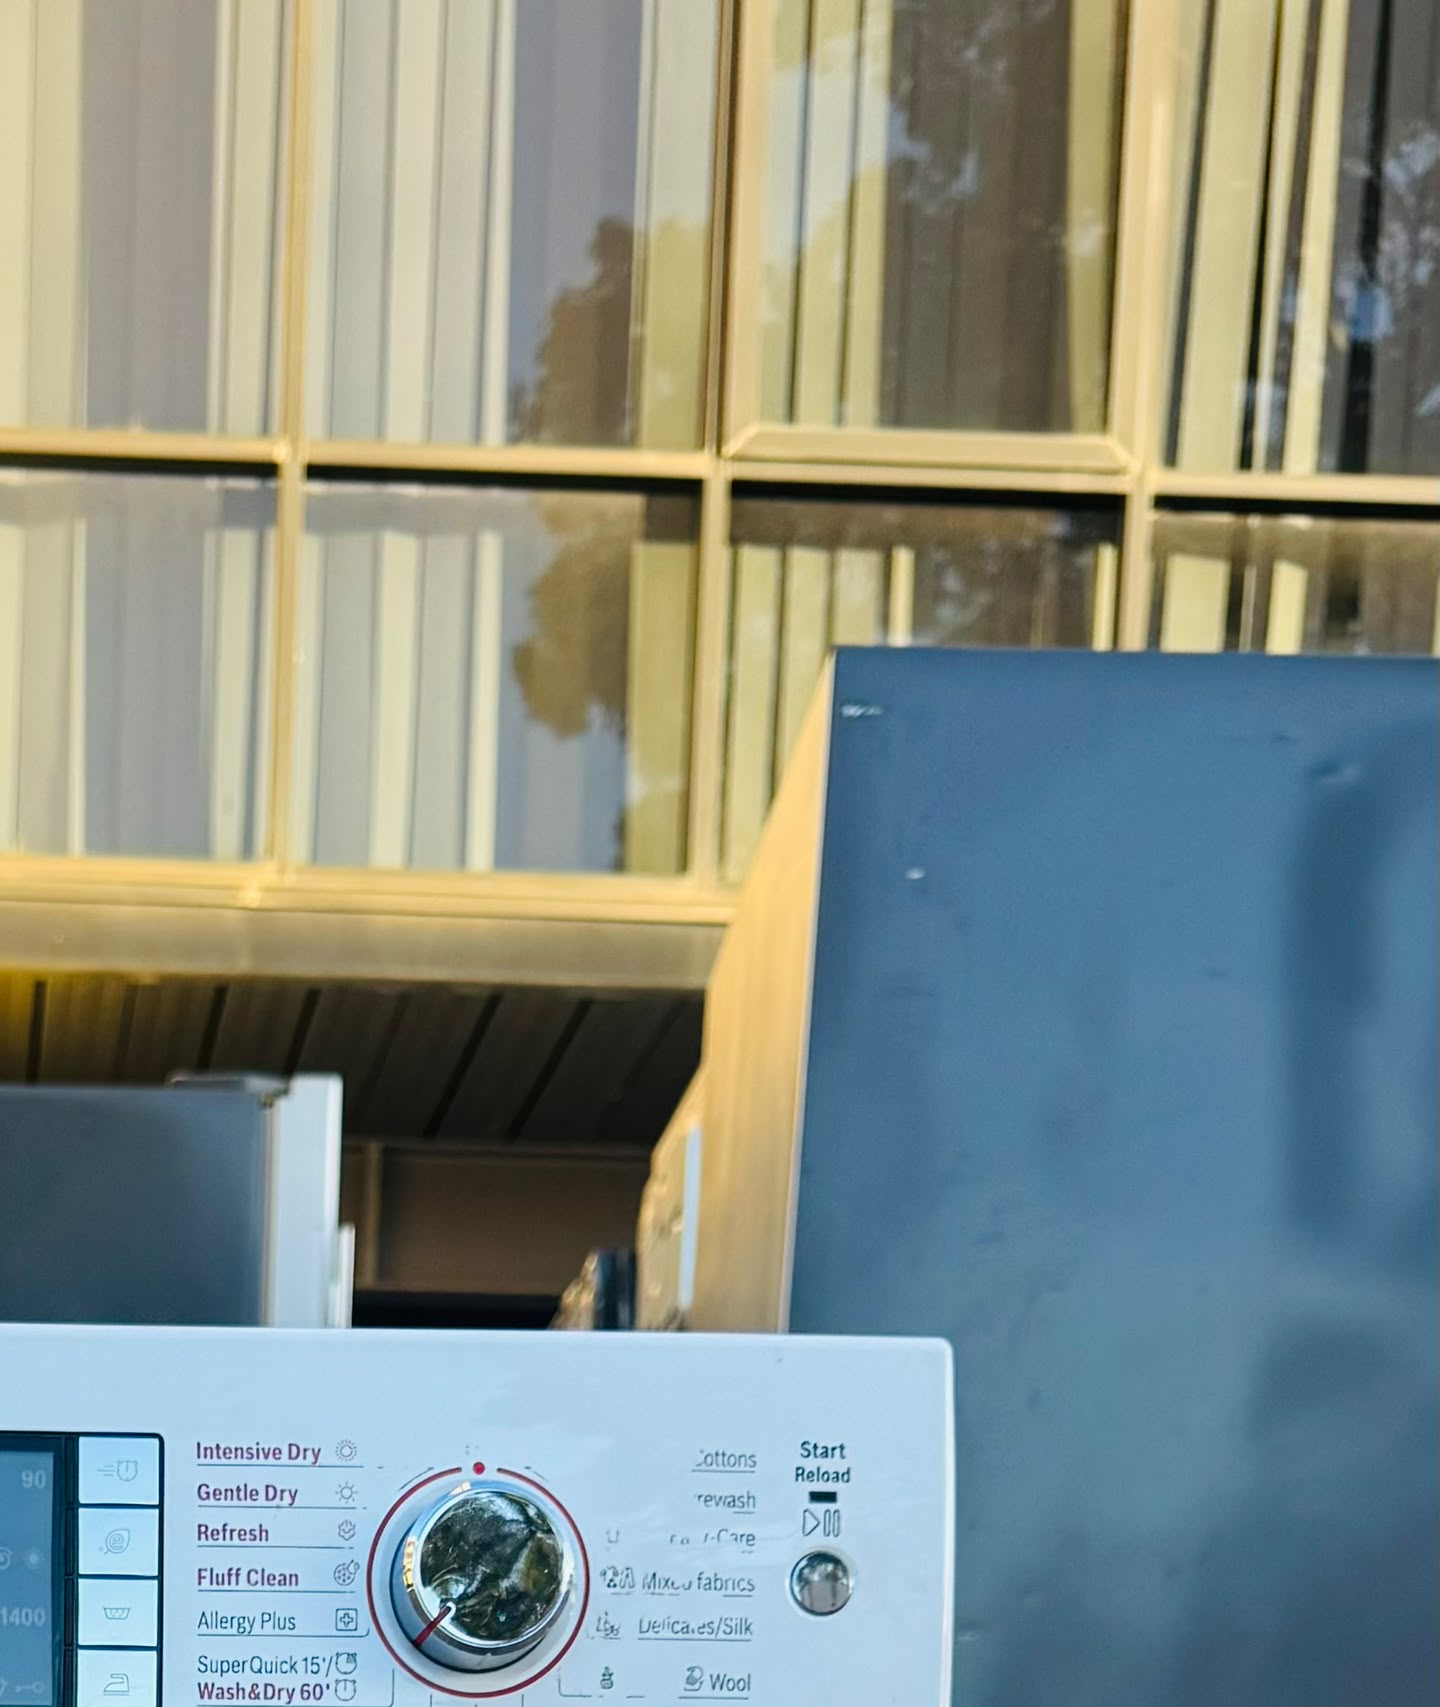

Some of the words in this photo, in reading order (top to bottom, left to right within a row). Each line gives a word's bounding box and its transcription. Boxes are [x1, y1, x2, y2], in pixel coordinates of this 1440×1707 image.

[196, 1442, 282, 1461] Intensive
[288, 1443, 321, 1466] Dry
[800, 1441, 846, 1460] Start
[21, 1470, 46, 1489] 90
[795, 1466, 851, 1484] Reload
[197, 1483, 259, 1502] Gentle
[264, 1484, 298, 1506] Dry
[197, 1523, 269, 1542] Refresh
[197, 1568, 242, 1586] Fluff
[246, 1568, 299, 1587] Clean
[697, 1571, 755, 1592] fabrics
[1, 1607, 46, 1627] 1400
[197, 1611, 255, 1634] Allergy
[260, 1612, 296, 1631] Plus
[639, 1616, 753, 1638] Delicaes/Silk
[709, 1672, 751, 1692] Wool
[197, 1682, 295, 1704] Wash&Dry
[300, 1682, 331, 1701] 60'
